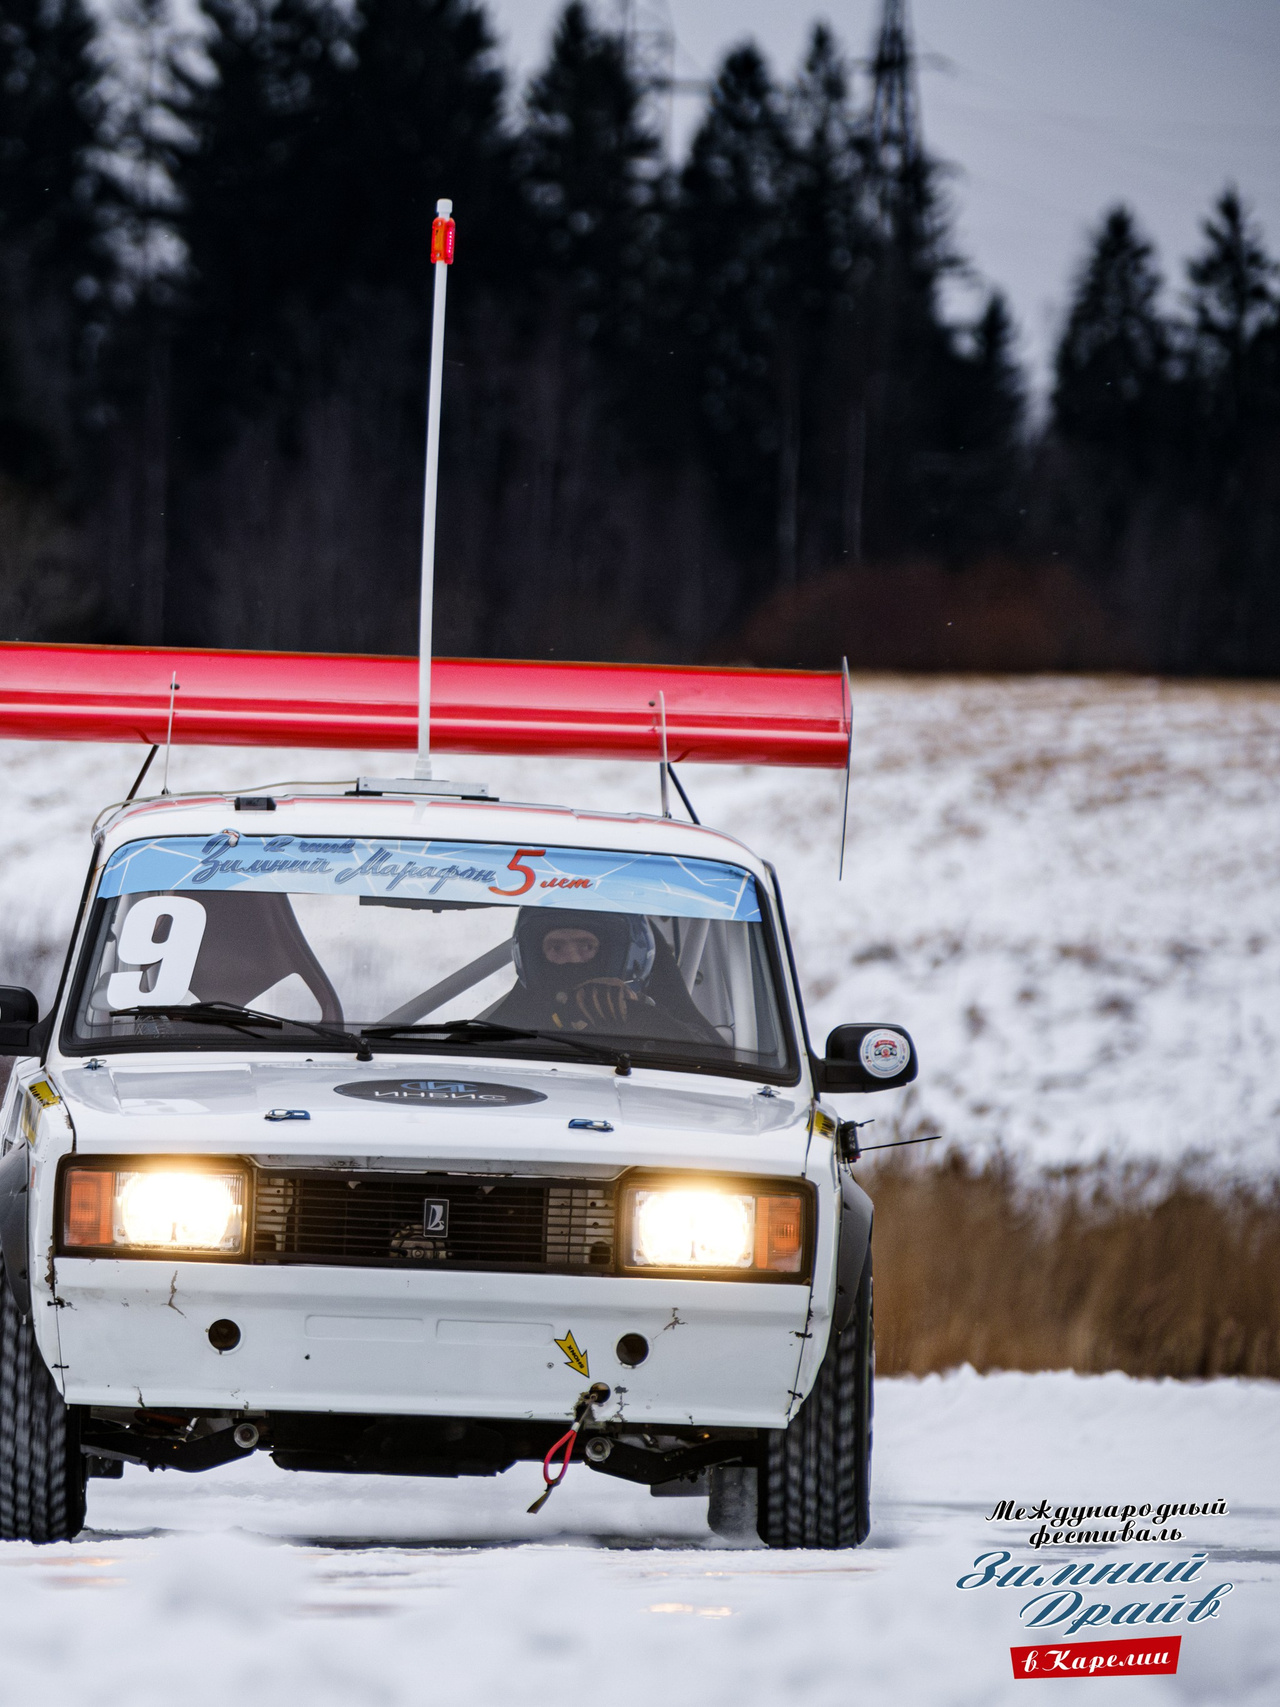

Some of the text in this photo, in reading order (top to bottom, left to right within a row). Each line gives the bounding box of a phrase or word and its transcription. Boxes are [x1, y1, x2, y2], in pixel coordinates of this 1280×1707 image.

[192, 834, 496, 894] Зимний Марафон
[488, 848, 593, 896] 5 лет
[107, 895, 207, 1010] 9
